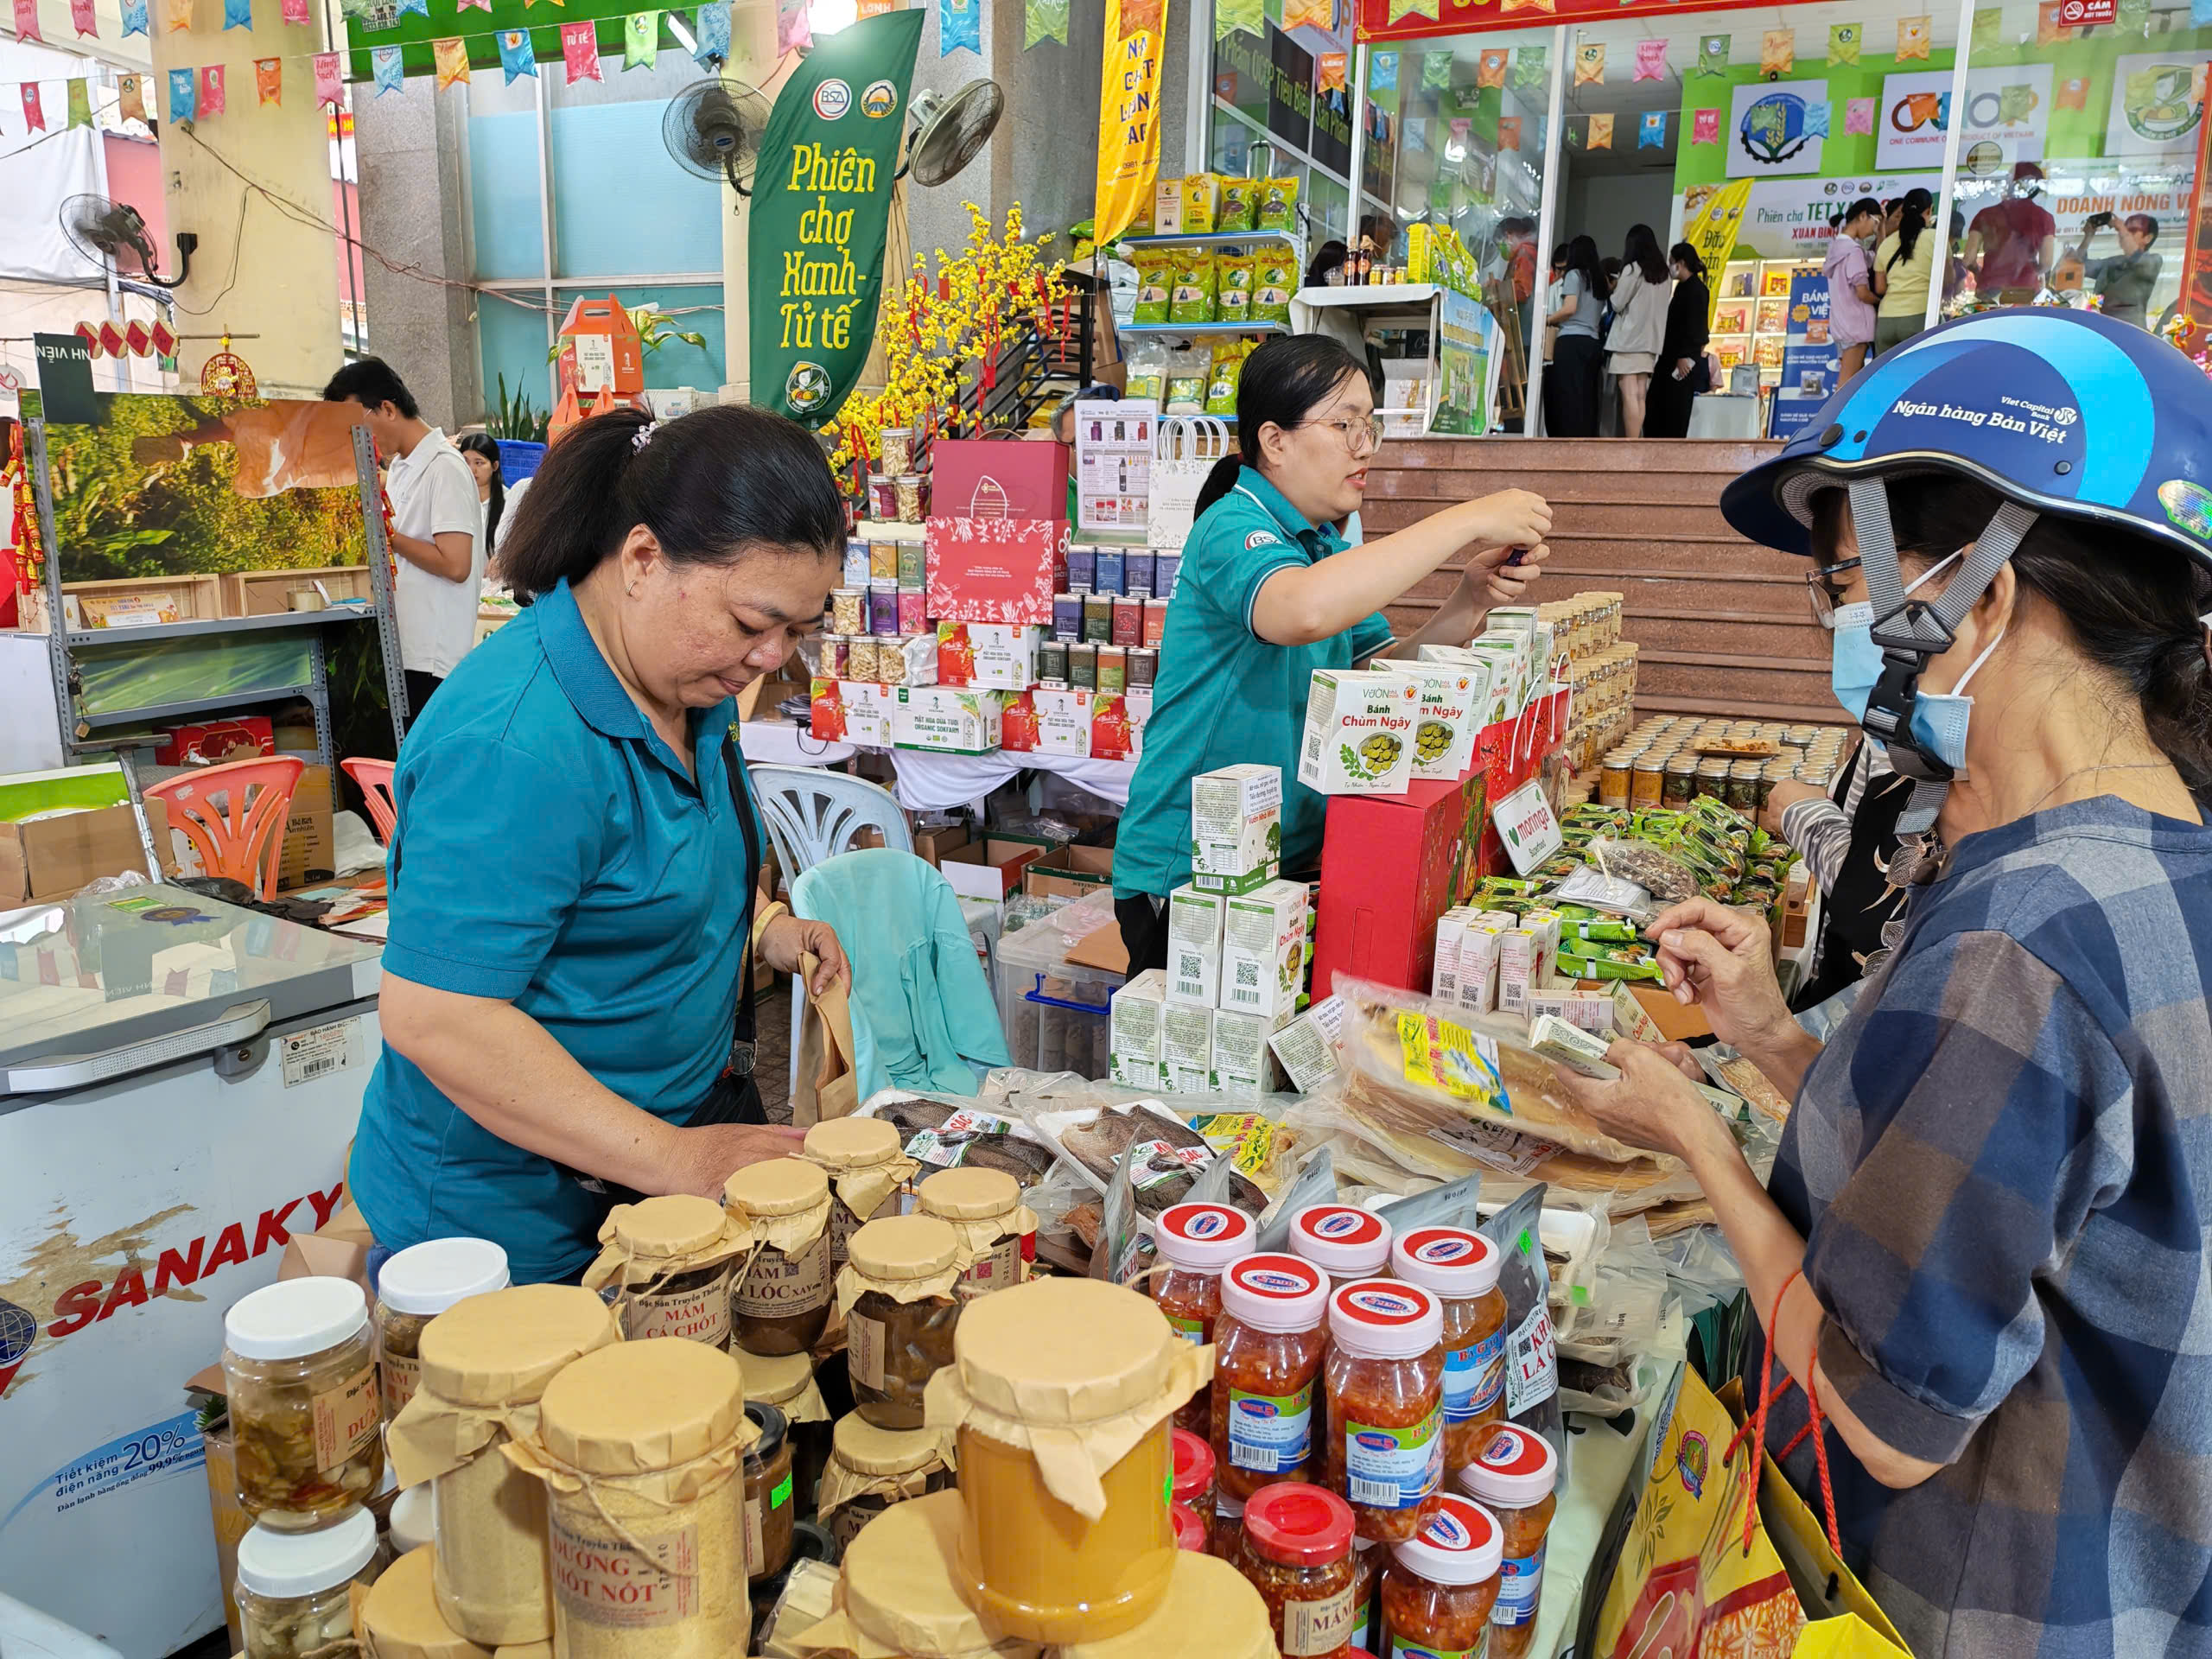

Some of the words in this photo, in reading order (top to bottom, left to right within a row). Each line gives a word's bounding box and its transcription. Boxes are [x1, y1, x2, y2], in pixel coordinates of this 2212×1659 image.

[787, 143, 876, 194] Phiên
[2056, 195, 2115, 214] DOANH
[798, 195, 855, 251] chợ
[779, 300, 817, 349] Tử
[821, 297, 862, 349] tế
[1892, 400, 1937, 417] Ngân
[1938, 403, 1987, 427] hàng
[1987, 412, 2026, 433] Bản
[2029, 421, 2067, 444] Việt
[2000, 396, 2019, 408] Viet
[2020, 400, 2055, 416] Capital
[2031, 411, 2051, 421] Bank
[1342, 715, 1378, 728] Chùm
[1380, 715, 1411, 731] Ngây
[1367, 704, 1390, 714] Bánh
[1433, 706, 1464, 720] Ngây
[1516, 806, 1550, 842] moringa
[48, 1182, 343, 1338] SANAKY
[749, 1282, 791, 1300] LÓC
[123, 1422, 186, 1471] 20%
[55, 1461, 82, 1484] Tiết
[86, 1453, 118, 1474] kiệm
[55, 1479, 84, 1498] điện
[87, 1465, 118, 1484] năng
[57, 1500, 75, 1513] Dàn
[77, 1491, 95, 1506] lạnh
[148, 1453, 185, 1475] 99,9%
